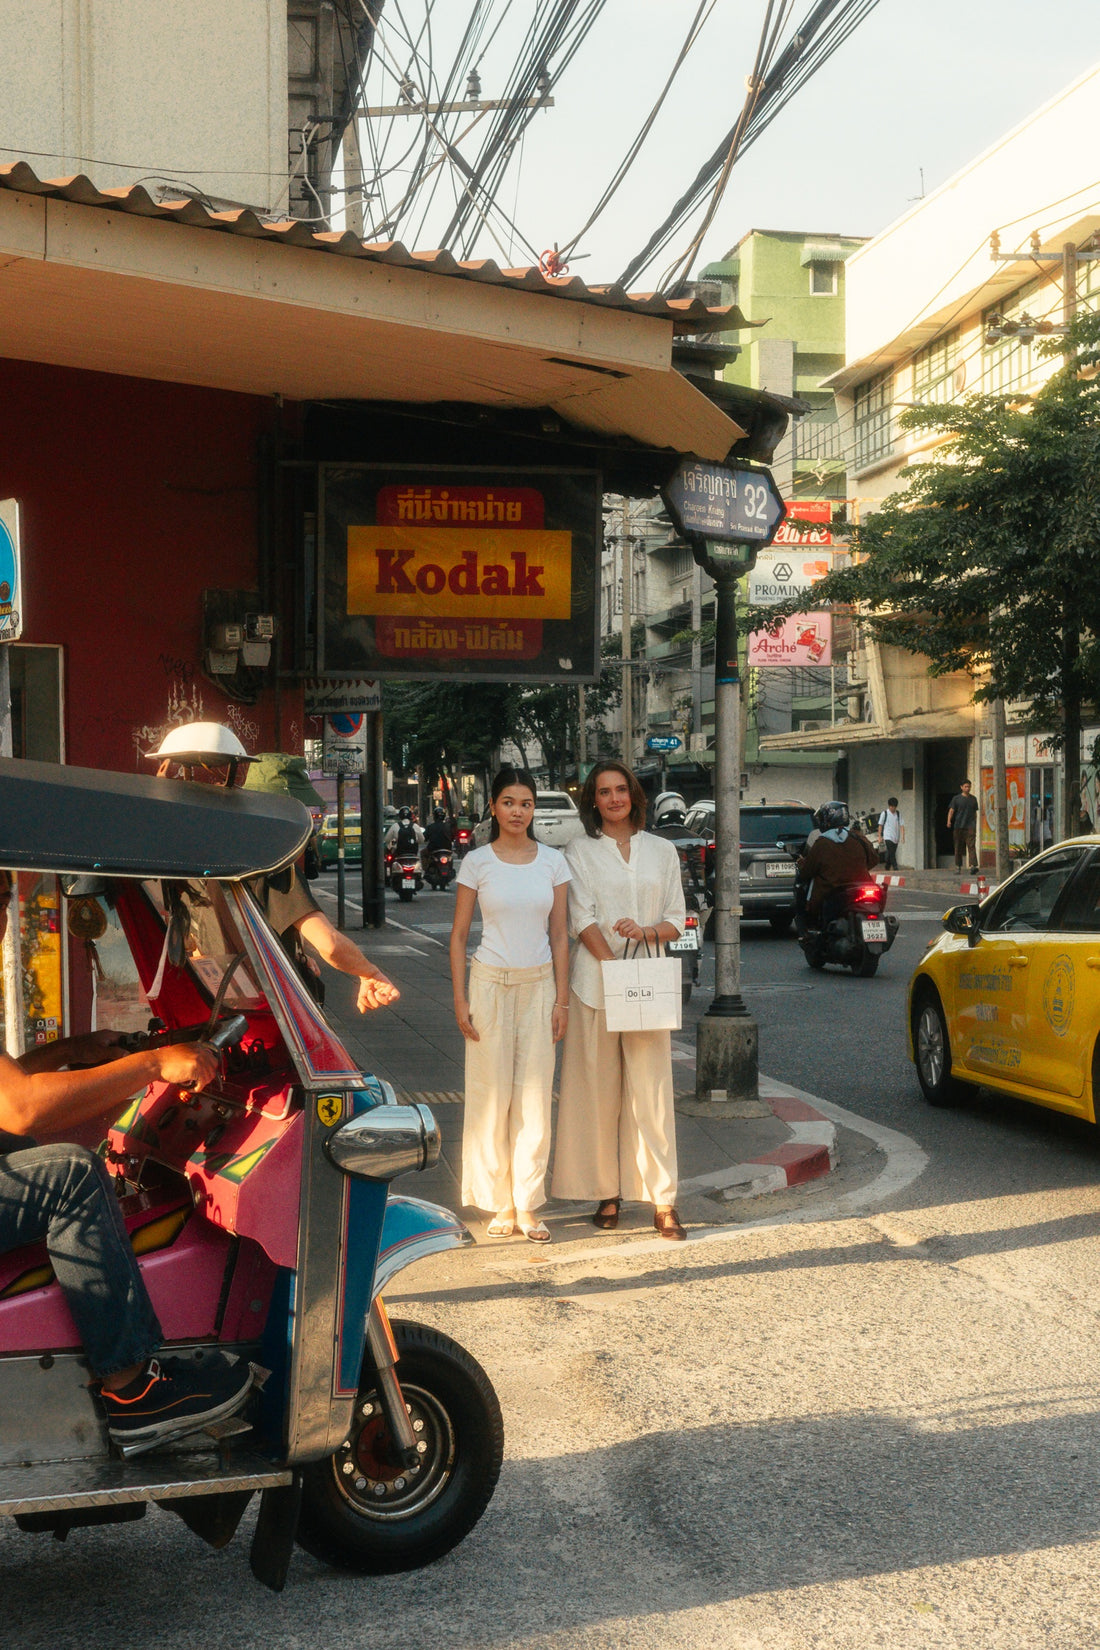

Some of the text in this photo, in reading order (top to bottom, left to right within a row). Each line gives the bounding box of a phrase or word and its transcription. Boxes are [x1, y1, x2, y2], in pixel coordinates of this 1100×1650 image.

[398, 488, 522, 522] ที่นี่จำหน่าย
[683, 464, 737, 506] เจริญกรุง
[744, 483, 768, 520] 32
[375, 549, 545, 597] Kodak
[394, 621, 524, 651] กล้อง-ฟิล์ม
[752, 638, 797, 653] Arché
[641, 989, 651, 997] La
